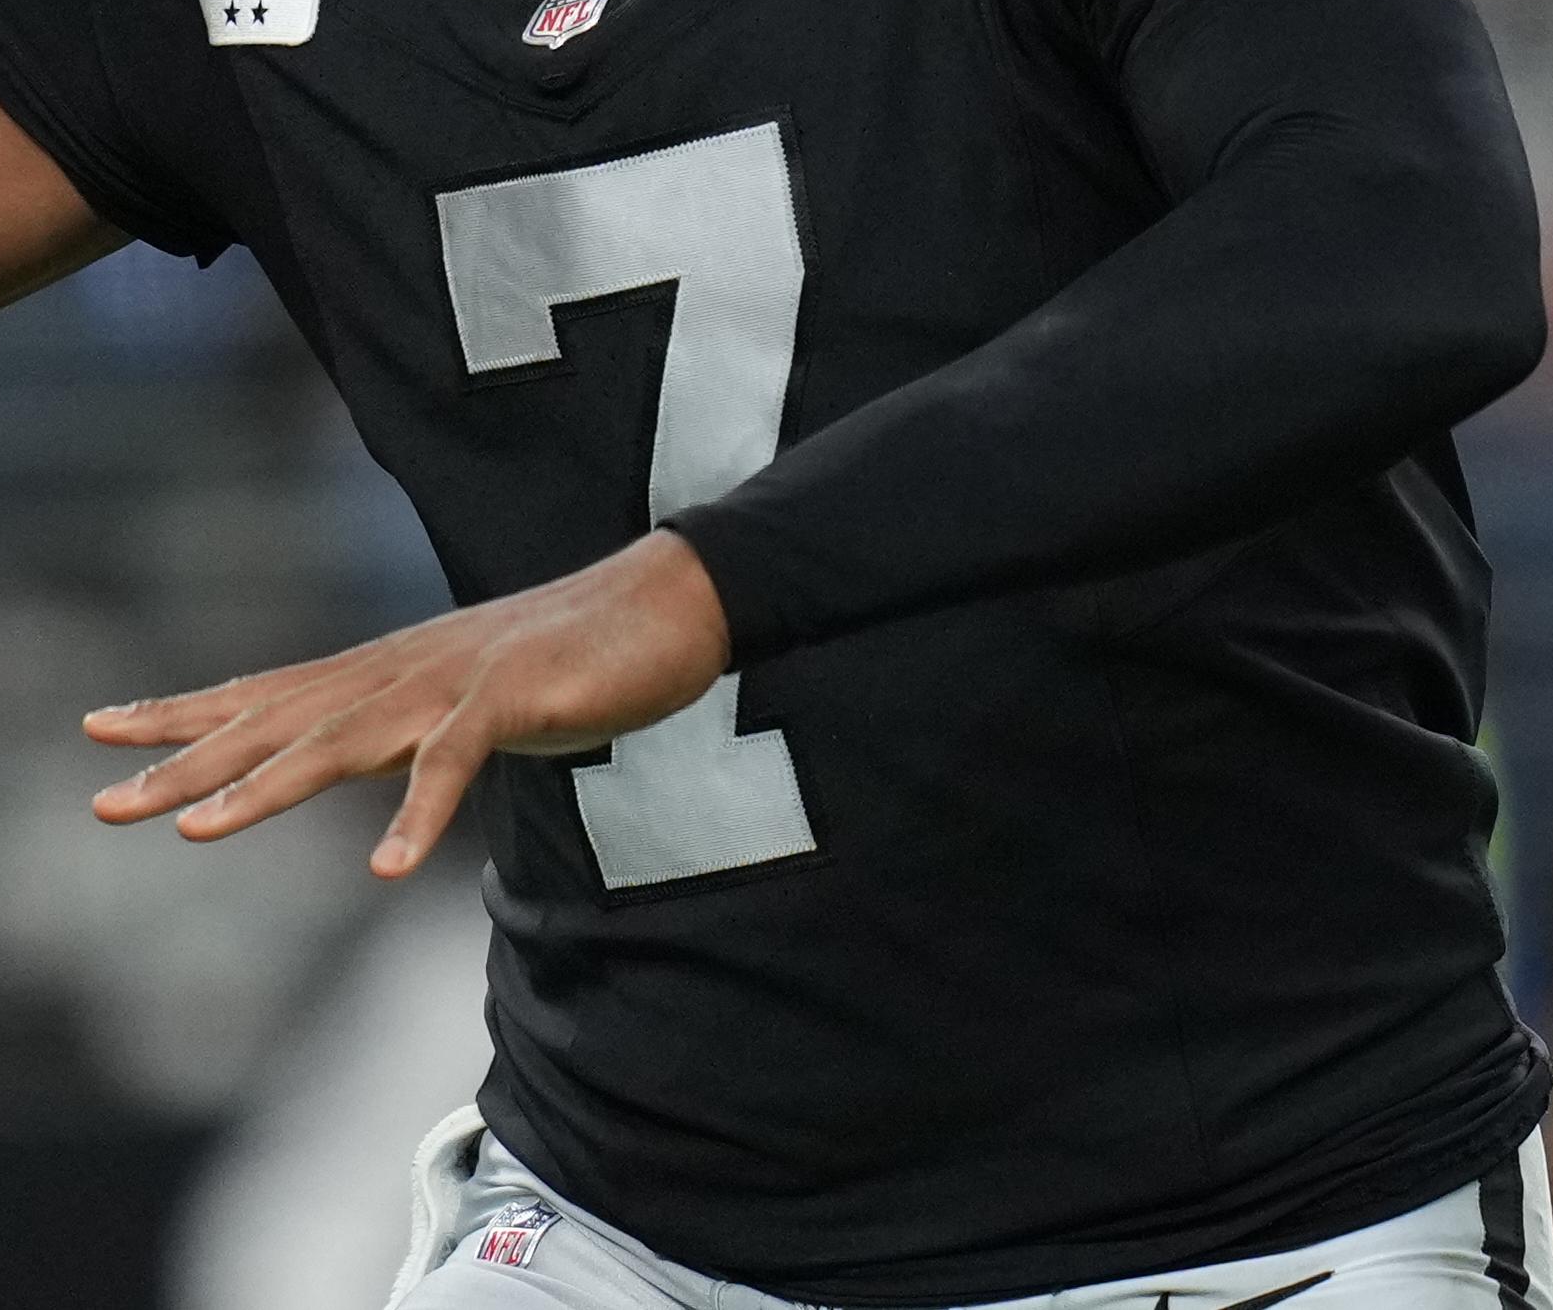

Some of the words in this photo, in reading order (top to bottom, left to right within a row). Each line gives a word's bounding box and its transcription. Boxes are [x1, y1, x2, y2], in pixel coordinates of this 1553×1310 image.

[537, 0, 591, 31] NFL
[435, 122, 816, 890] 7
[482, 1231, 527, 1265] NFL
